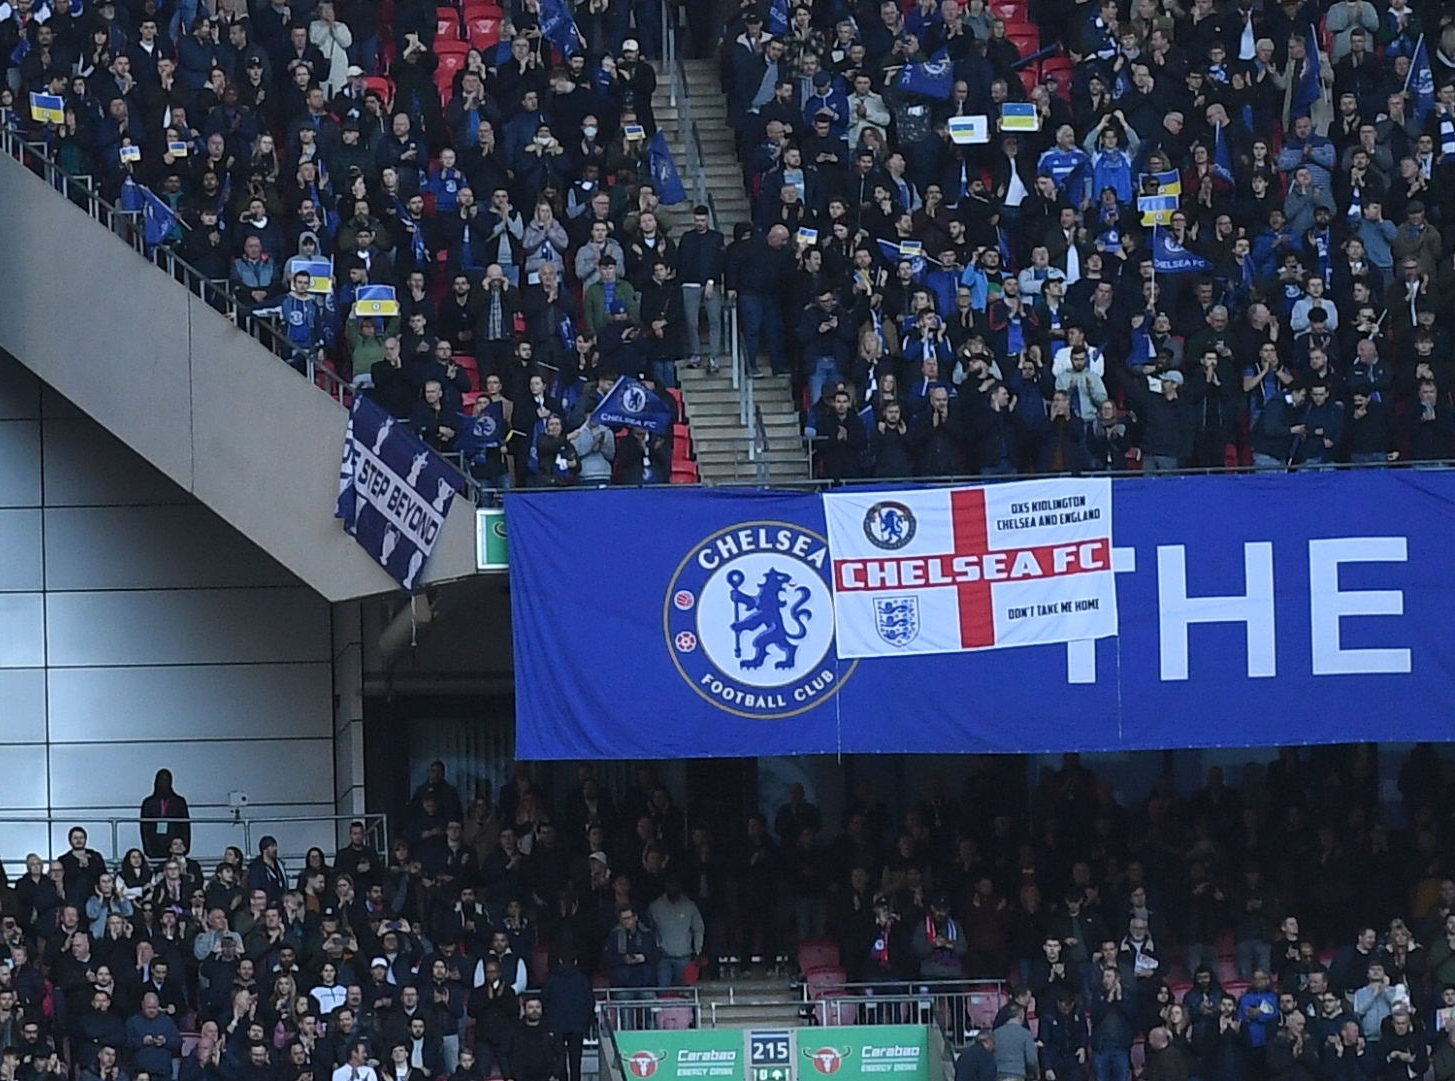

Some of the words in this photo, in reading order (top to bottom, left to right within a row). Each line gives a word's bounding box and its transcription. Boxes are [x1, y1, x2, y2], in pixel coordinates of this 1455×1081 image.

[600, 412, 642, 427] CHELSEA
[643, 420, 657, 429] FC
[358, 458, 391, 497] STEP
[386, 485, 439, 547] BEYOND
[1031, 495, 1087, 513] KIDLINGTON
[996, 515, 1037, 531] CHELSEA
[1039, 514, 1058, 527] AND
[1059, 507, 1101, 525] ENGLAND
[698, 529, 828, 570] CHELSEA
[840, 551, 1043, 589] CHELSEA
[1052, 541, 1105, 574] FC
[1008, 605, 1036, 621] DON'T
[1037, 604, 1060, 618] TAKE
[1061, 602, 1074, 614] ME
[1075, 598, 1101, 612] HOME
[701, 673, 787, 708] FOOTBALL
[793, 669, 835, 701] CLUB
[677, 1050, 737, 1063] Carabao
[752, 1041, 789, 1060] 215
[861, 1044, 921, 1058] Carabao
